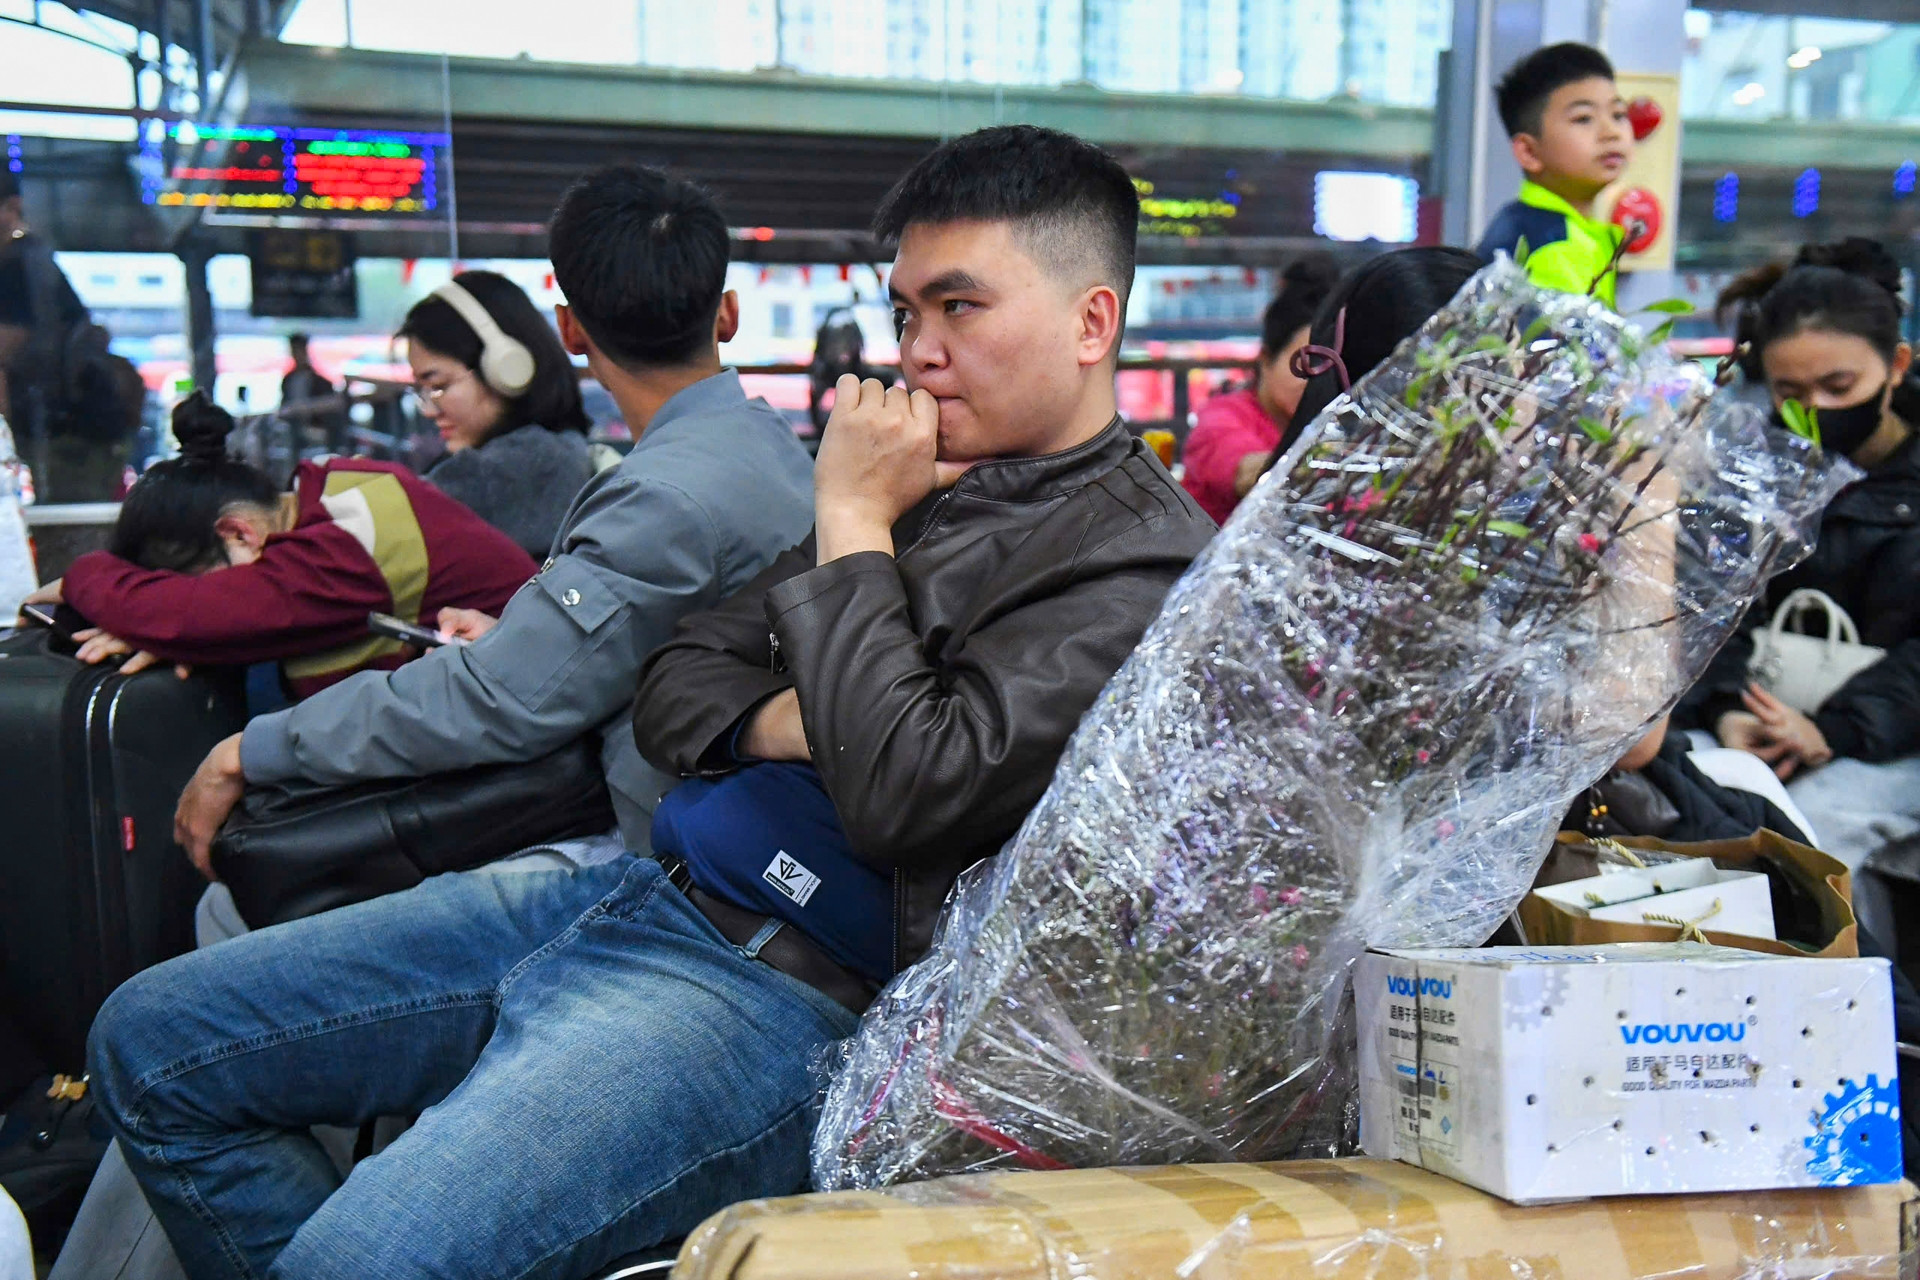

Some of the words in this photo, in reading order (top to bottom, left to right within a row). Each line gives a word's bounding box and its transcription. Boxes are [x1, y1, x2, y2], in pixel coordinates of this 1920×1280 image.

[1387, 975, 1451, 999] VOUVOU
[1621, 1022, 1745, 1044] VOUVOU
[1684, 1080, 1700, 1089] FOR
